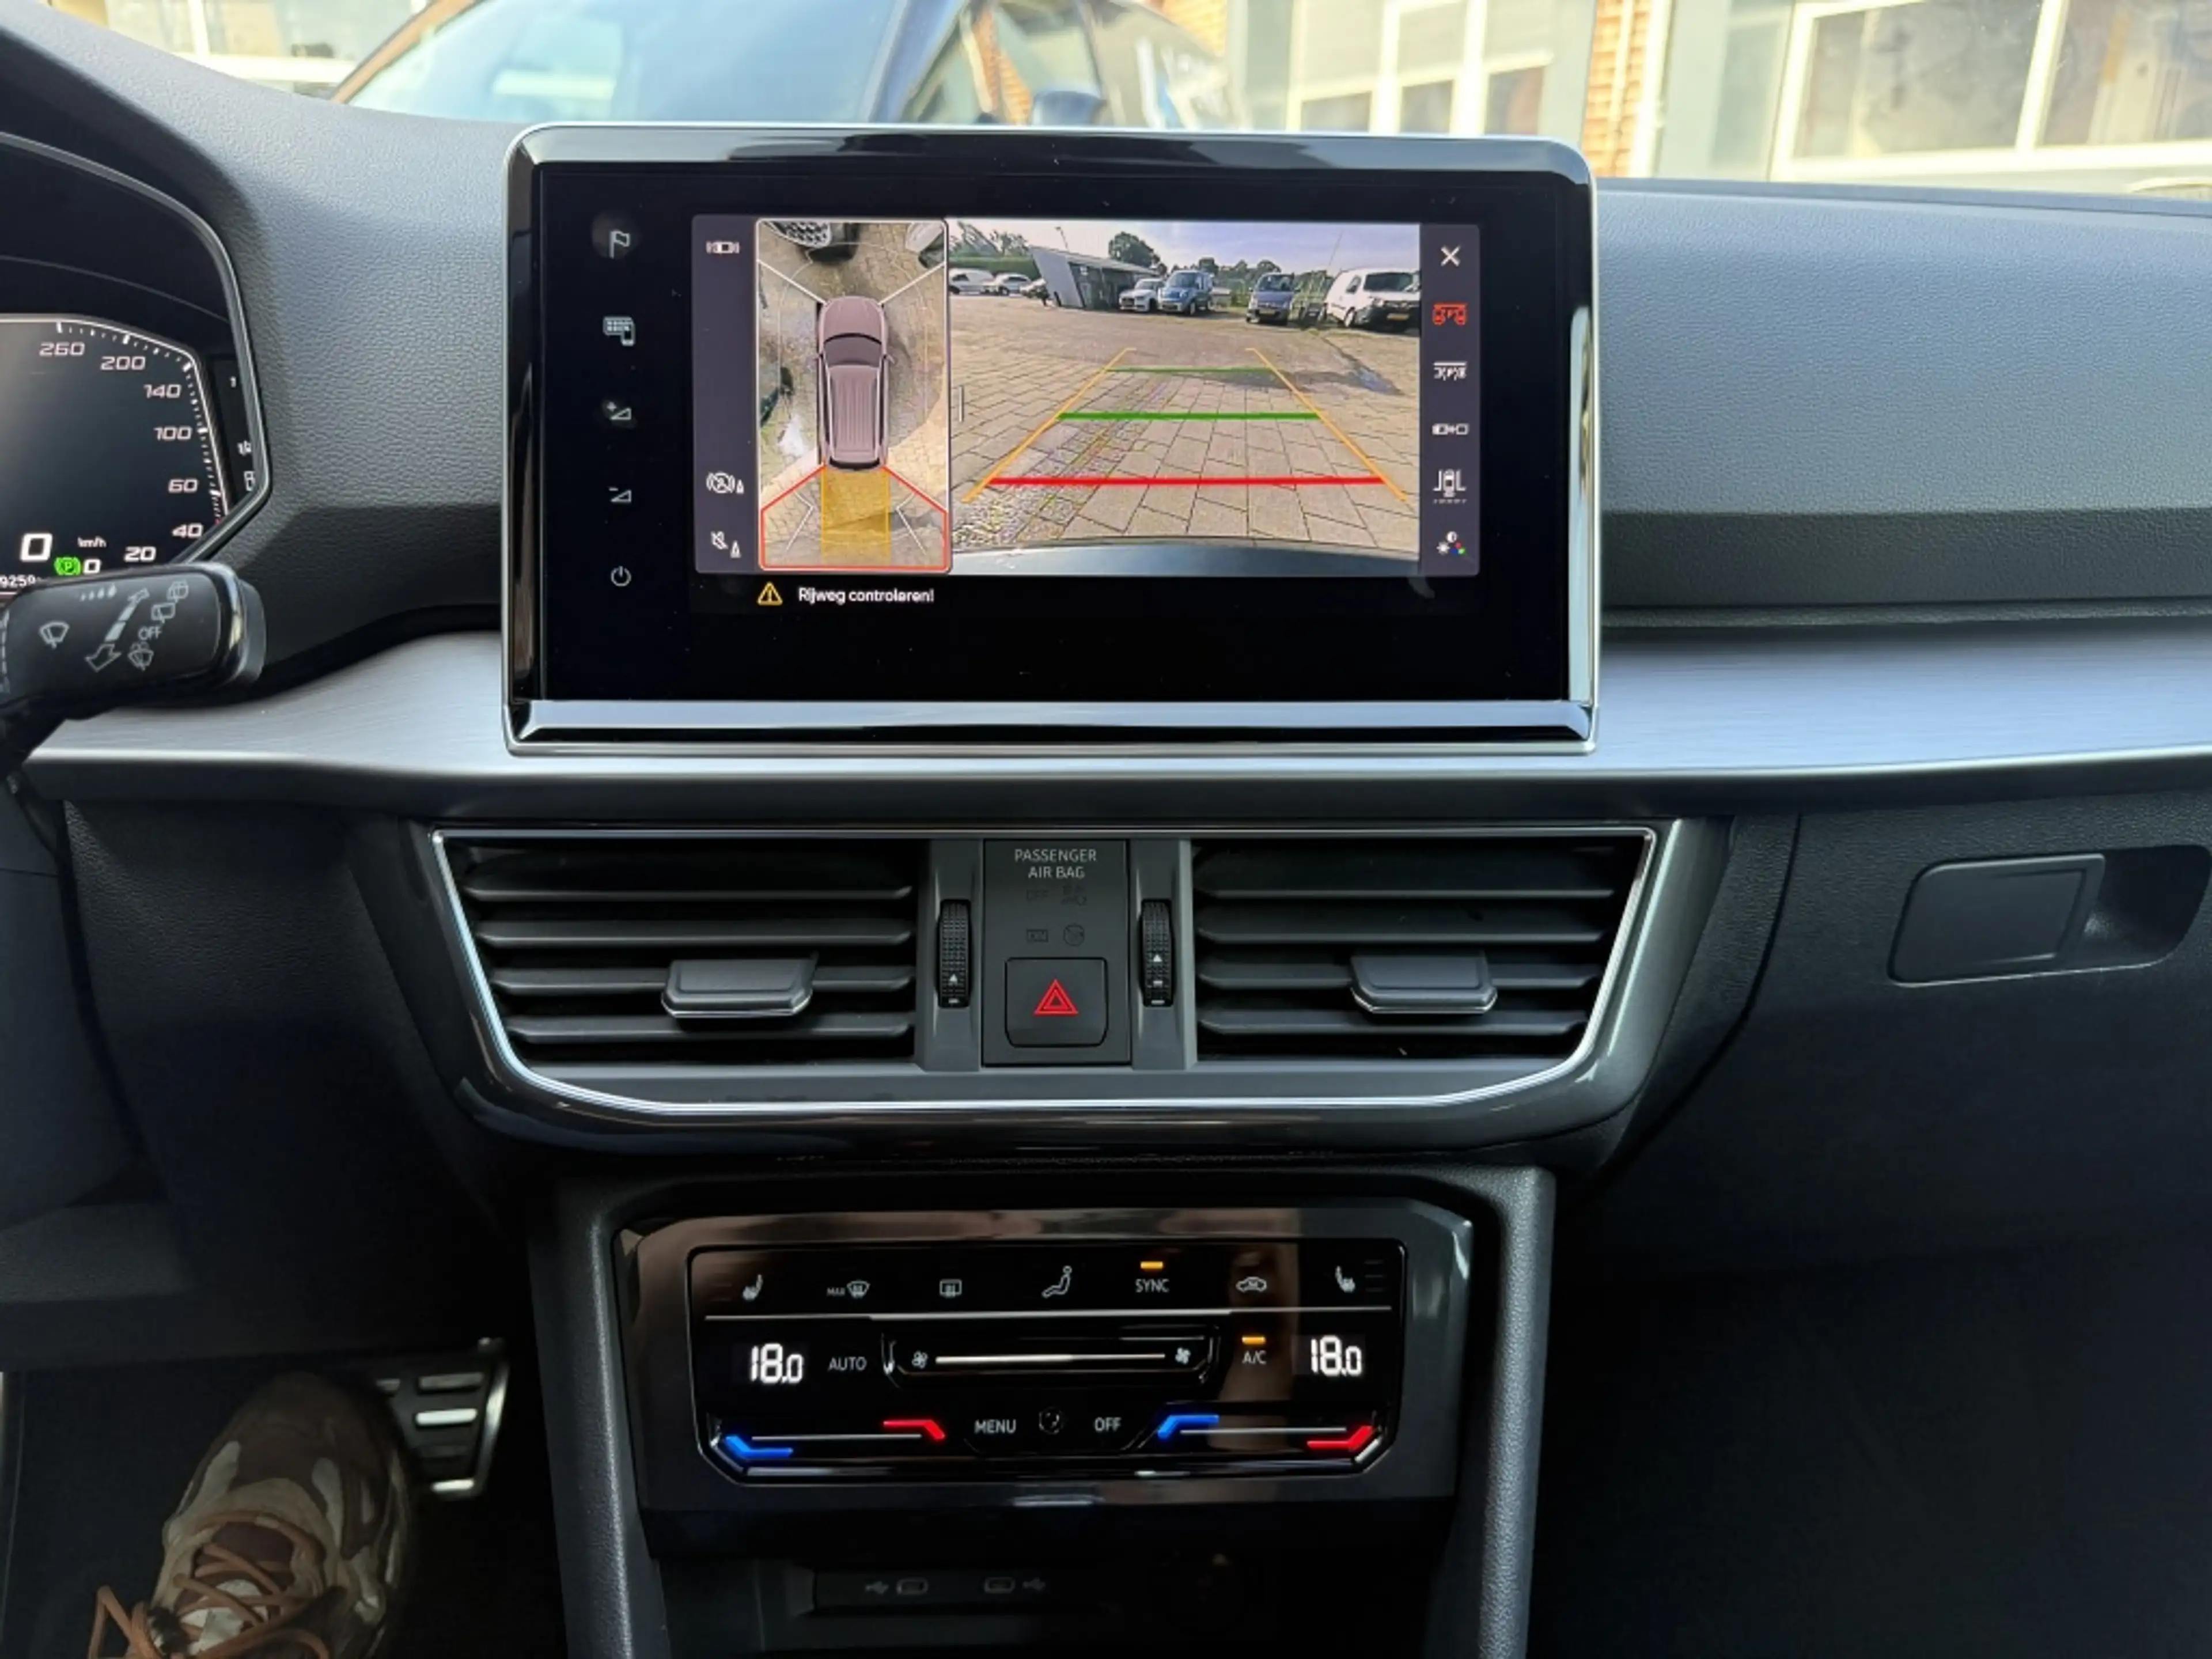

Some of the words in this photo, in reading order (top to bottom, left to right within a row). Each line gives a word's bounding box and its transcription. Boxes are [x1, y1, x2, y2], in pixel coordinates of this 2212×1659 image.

[39, 342, 86, 357] 260
[100, 355, 146, 371] 200
[143, 383, 181, 399] 140
[153, 426, 193, 441] 100
[168, 478, 199, 493] 60
[172, 522, 203, 539] 40
[20, 533, 53, 562] 0
[77, 536, 107, 548] km/h
[124, 546, 157, 563] 20
[82, 558, 102, 575] 0
[798, 586, 846, 605] Rijweg
[848, 587, 934, 603] controleren!
[138, 624, 162, 641] OFF
[1014, 848, 1097, 863] PASSENGER
[1028, 866, 1052, 879] AIR
[1055, 866, 1085, 879] BAG
[1135, 1278, 1169, 1293] SYNC
[751, 1343, 804, 1384] 18.0
[828, 1356, 867, 1372] AUTO
[1241, 1349, 1267, 1365] A/C
[1310, 1335, 1362, 1377] 18.0
[974, 1418, 1017, 1434] MENU
[1094, 1416, 1122, 1433] OFF
